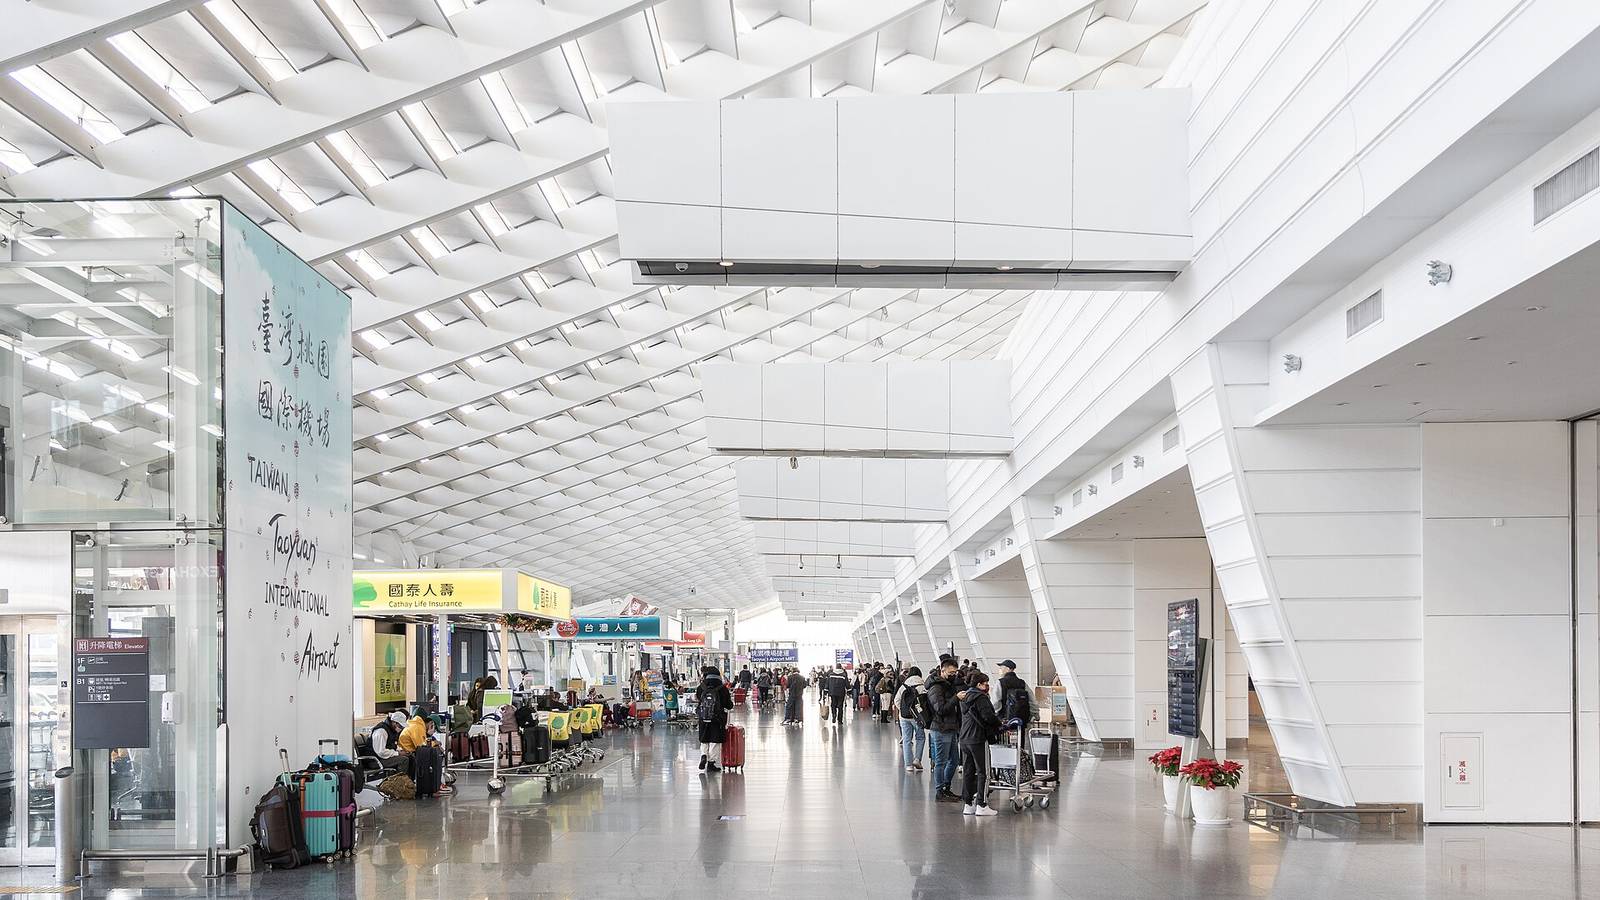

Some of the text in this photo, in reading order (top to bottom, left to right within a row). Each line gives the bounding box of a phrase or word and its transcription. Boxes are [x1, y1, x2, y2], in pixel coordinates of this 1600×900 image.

[248, 455, 289, 497] TAIWAN
[268, 513, 317, 577] Taoyuan
[265, 582, 329, 617] INTERNATIONAL
[388, 583, 454, 597] 國泰人壽
[388, 600, 413, 608] Cathay
[584, 622, 638, 633] 台灣人壽
[89, 641, 123, 650] 升降電梯
[299, 629, 339, 682] Airport
